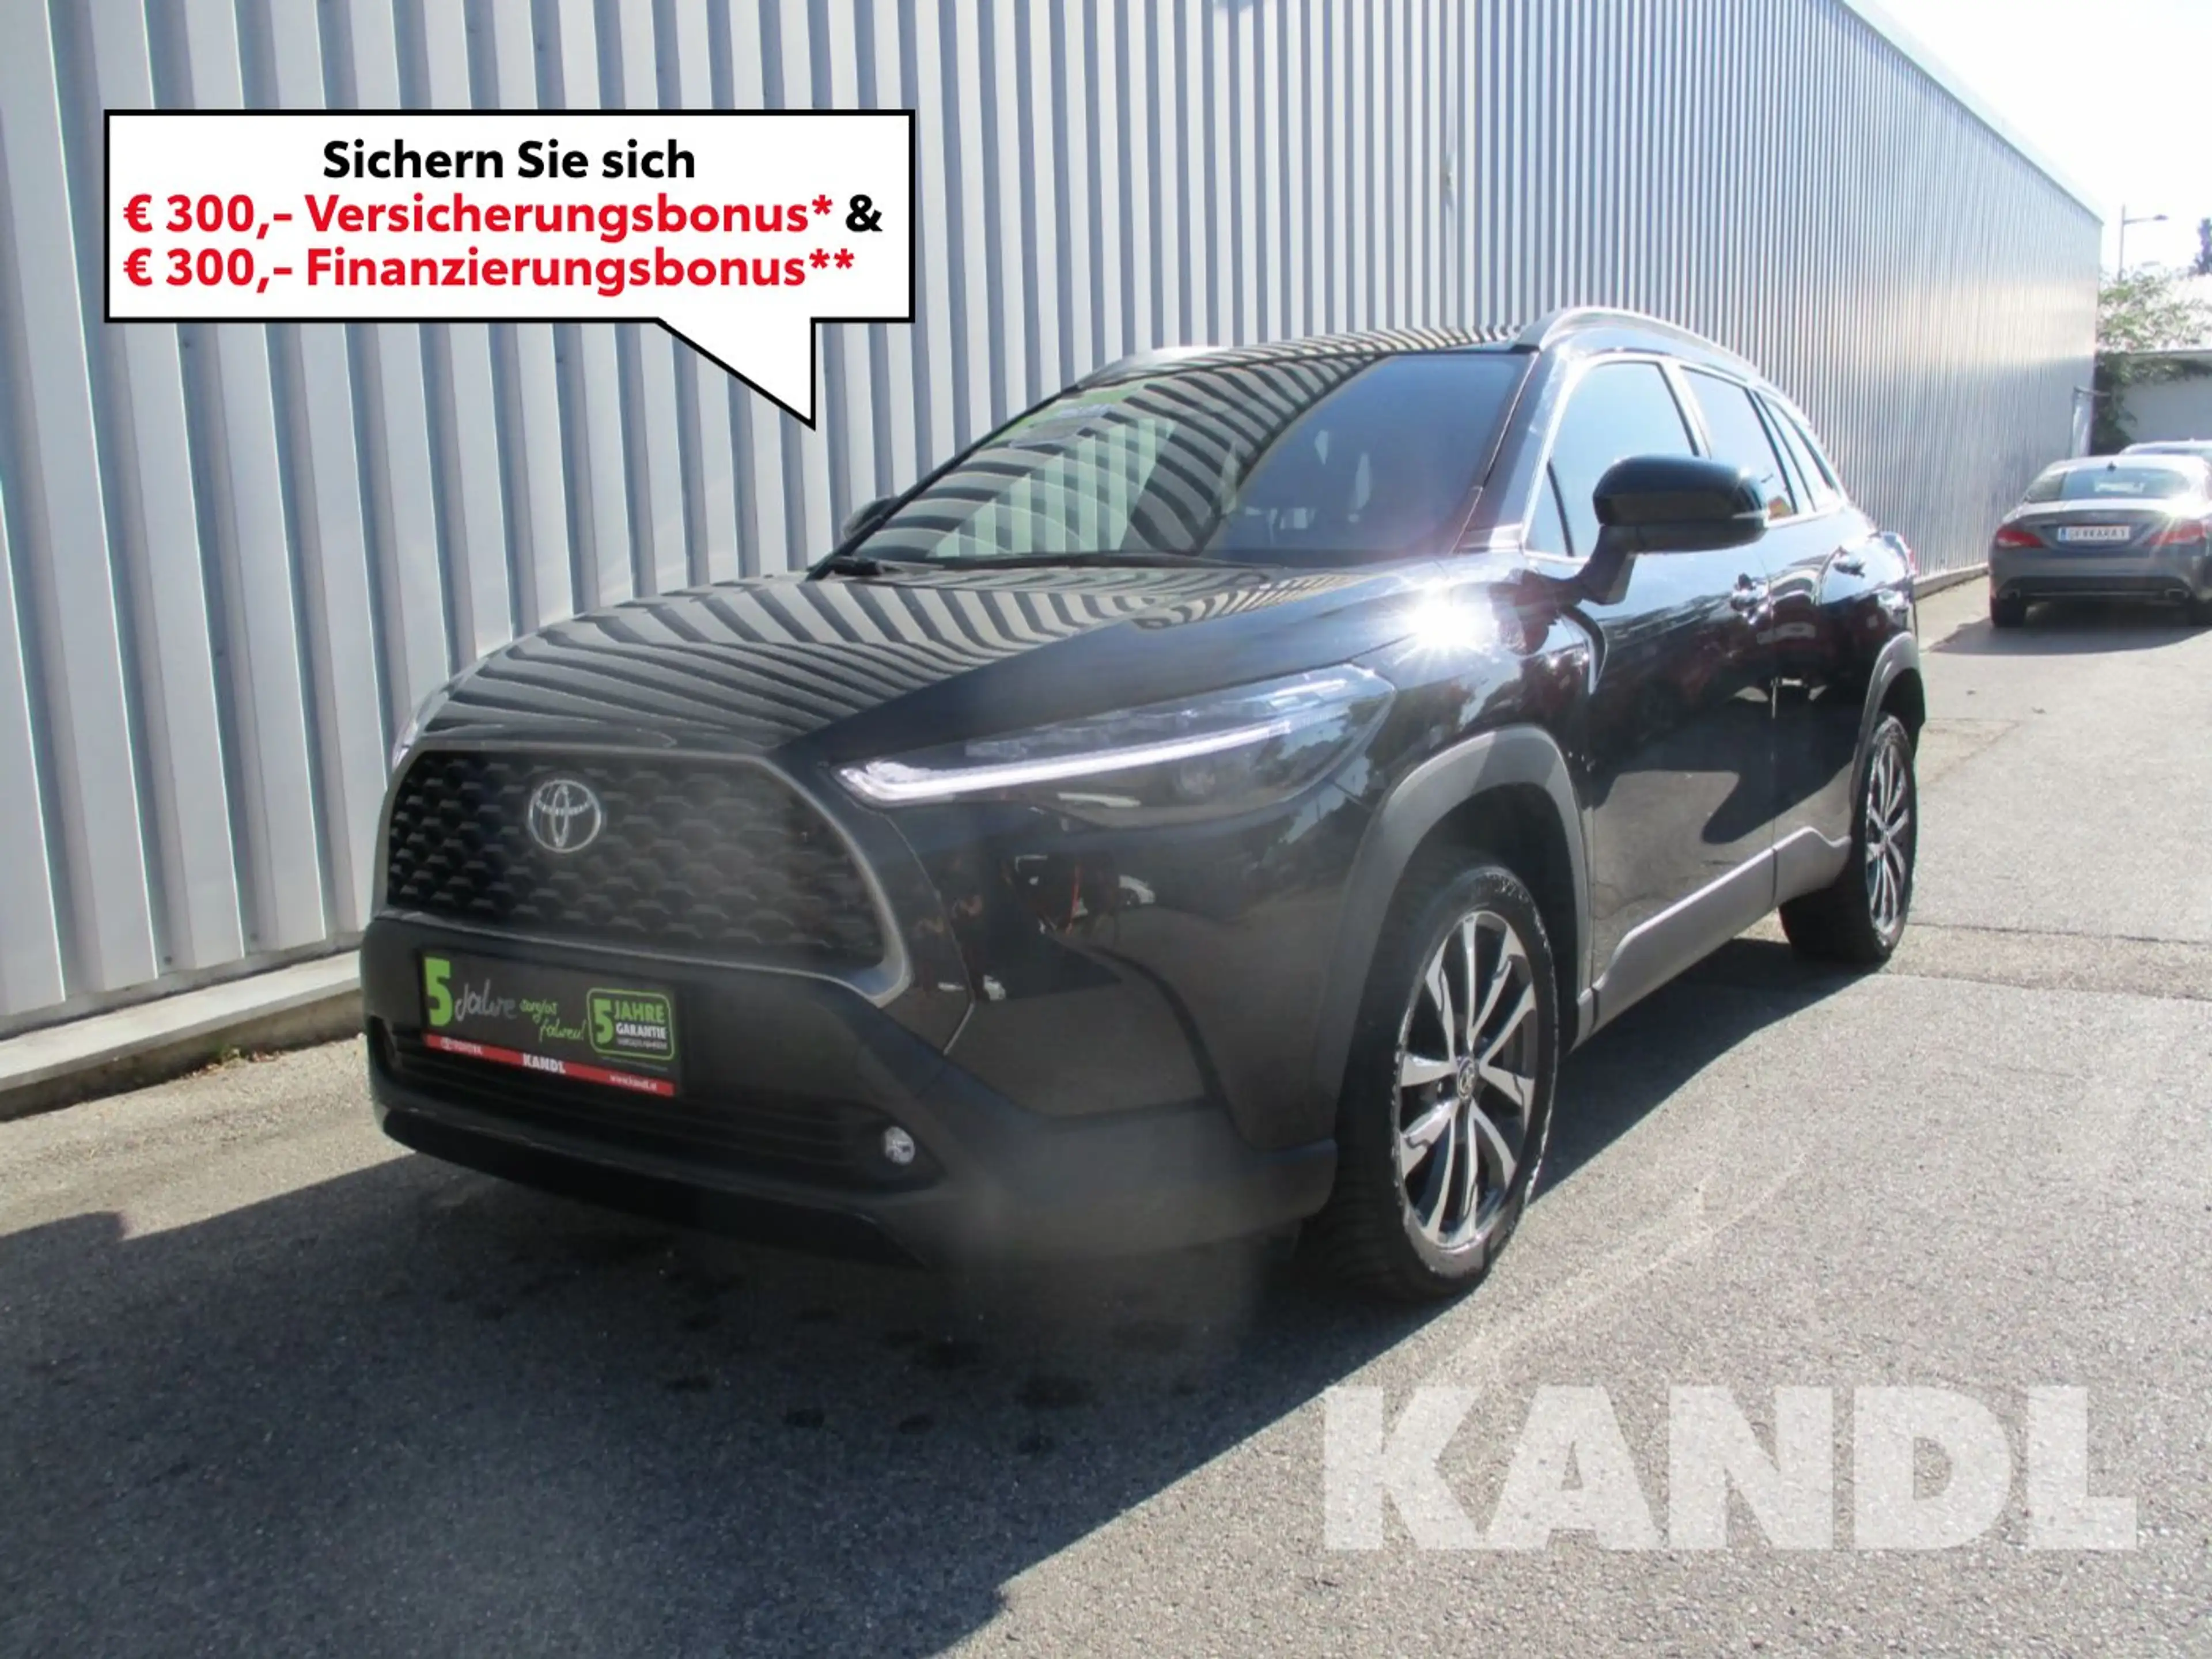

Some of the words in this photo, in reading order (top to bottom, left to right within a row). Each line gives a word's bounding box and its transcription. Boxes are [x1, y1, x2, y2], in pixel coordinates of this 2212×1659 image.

[424, 956, 453, 1027] 5
[593, 998, 614, 1044] 5
[614, 999, 665, 1024] JAHRE
[615, 1022, 666, 1040] GARANTIE
[522, 1053, 566, 1074] KANDL
